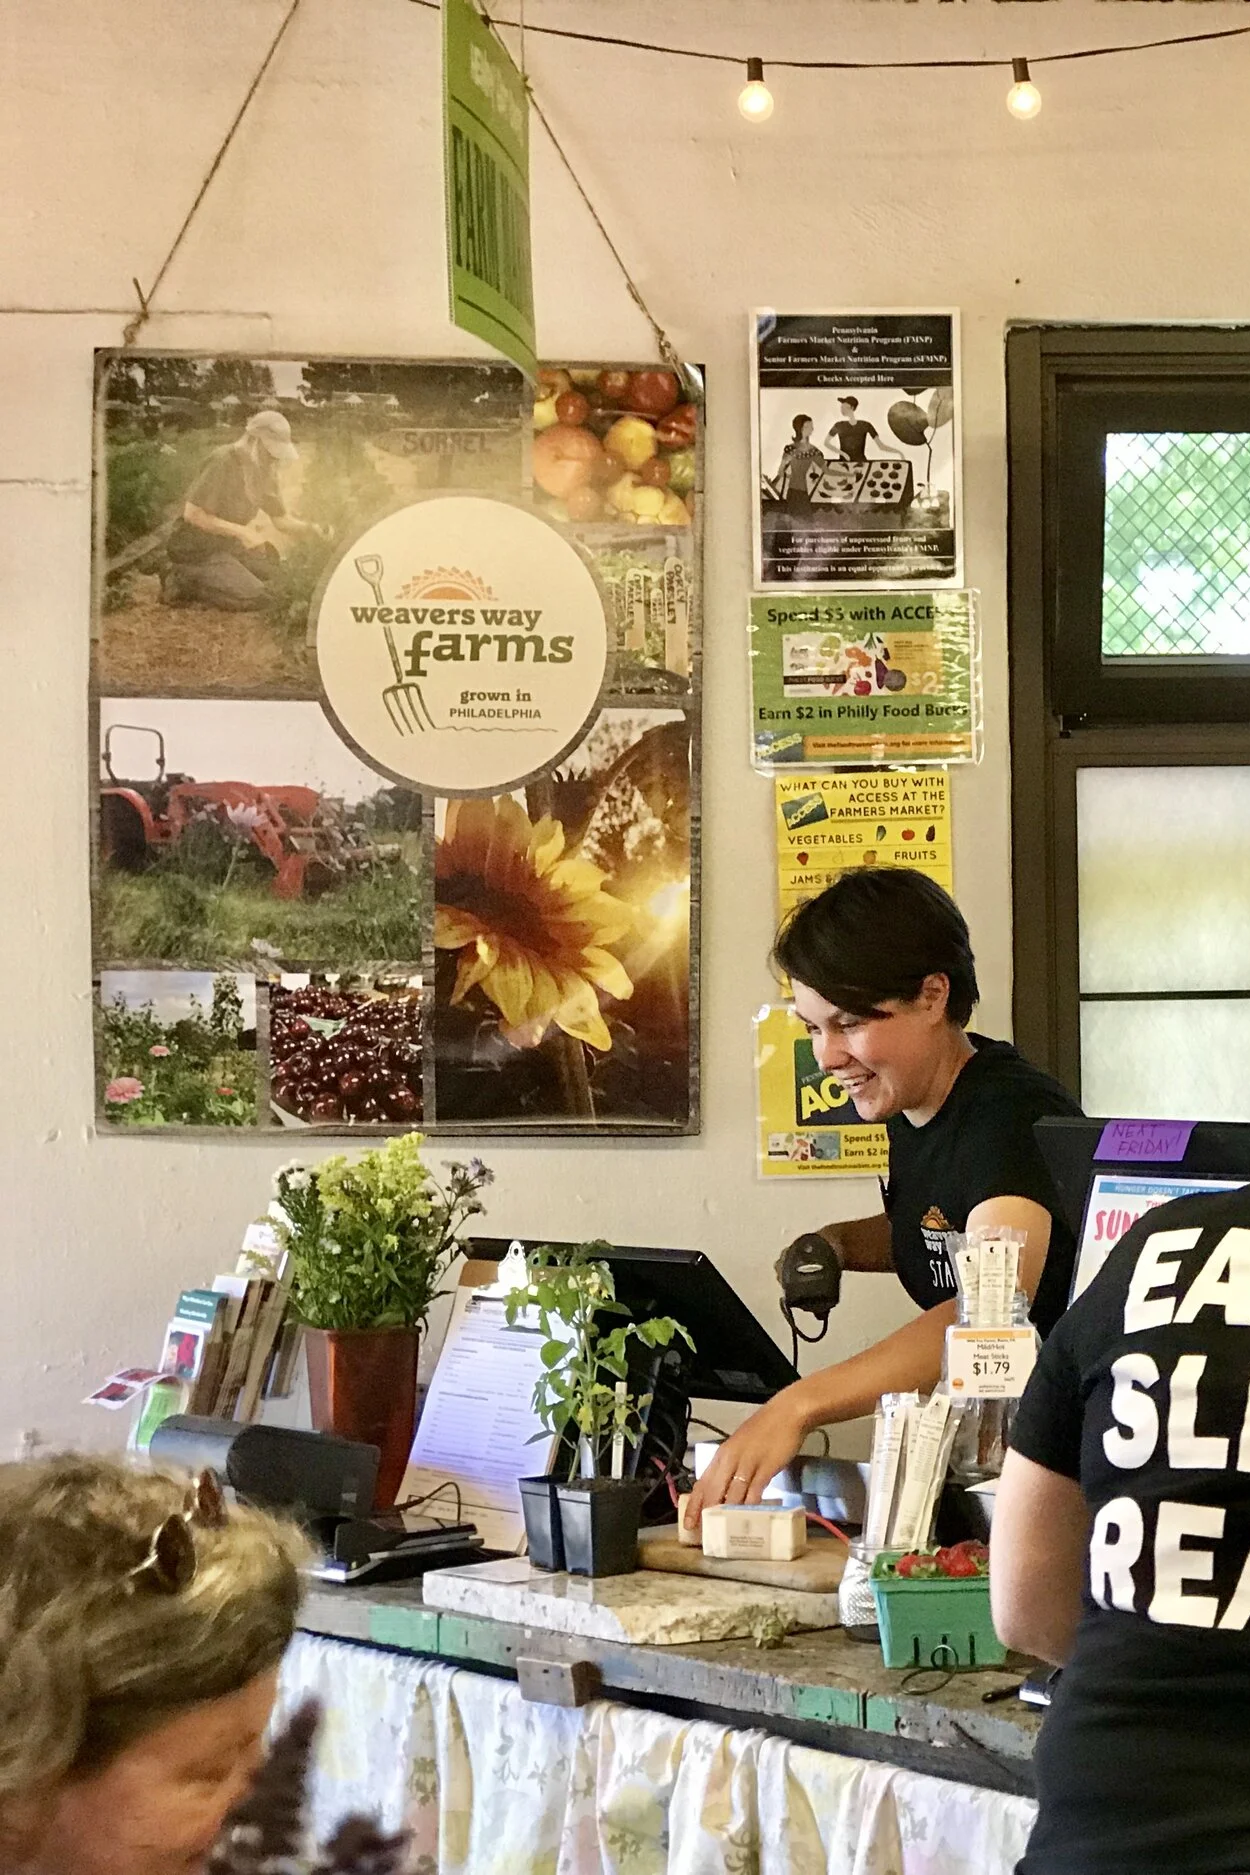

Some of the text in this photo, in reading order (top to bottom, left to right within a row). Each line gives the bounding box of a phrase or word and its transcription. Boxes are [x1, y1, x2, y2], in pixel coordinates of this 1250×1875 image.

[809, 336, 836, 344] Market
[837, 336, 870, 344] Nutrition
[871, 336, 902, 345] Program
[903, 335, 933, 344] (FMNP)
[764, 355, 948, 364] Senior Farmers Market Nutrition Program (SFMNP)
[845, 374, 876, 383] Accepted
[877, 374, 894, 382] Here
[402, 431, 492, 454] SORREL
[841, 545, 861, 553] under
[777, 565, 792, 573] This
[830, 564, 836, 572] is
[848, 565, 868, 574] equal
[350, 606, 542, 632] weavers way
[767, 606, 942, 625] Spend $5 with ACCE
[404, 629, 574, 678] farms
[460, 689, 531, 704] grown in
[449, 708, 542, 719] PHILADELPHIA
[759, 707, 791, 720] Earn
[796, 706, 814, 720] $2
[819, 705, 832, 719] in
[837, 703, 878, 721] Philly
[883, 702, 920, 717] Food
[780, 777, 944, 792] WHAT CAN YOU BUY WITH
[849, 790, 945, 803] ACCESS AT THE
[830, 804, 946, 817] FARMERS MARKET?
[788, 833, 864, 845] VEGETABLES
[894, 850, 937, 861] FRUITS
[790, 874, 822, 885] JAMS
[1111, 1122, 1167, 1139] NEXT
[844, 1133, 885, 1145] Spend $5
[844, 1148, 864, 1157] Earn
[867, 1148, 878, 1157] $2
[880, 1148, 888, 1156] in
[1114, 1184, 1146, 1193] HUNGER
[972, 1361, 1010, 1376] $1.79
